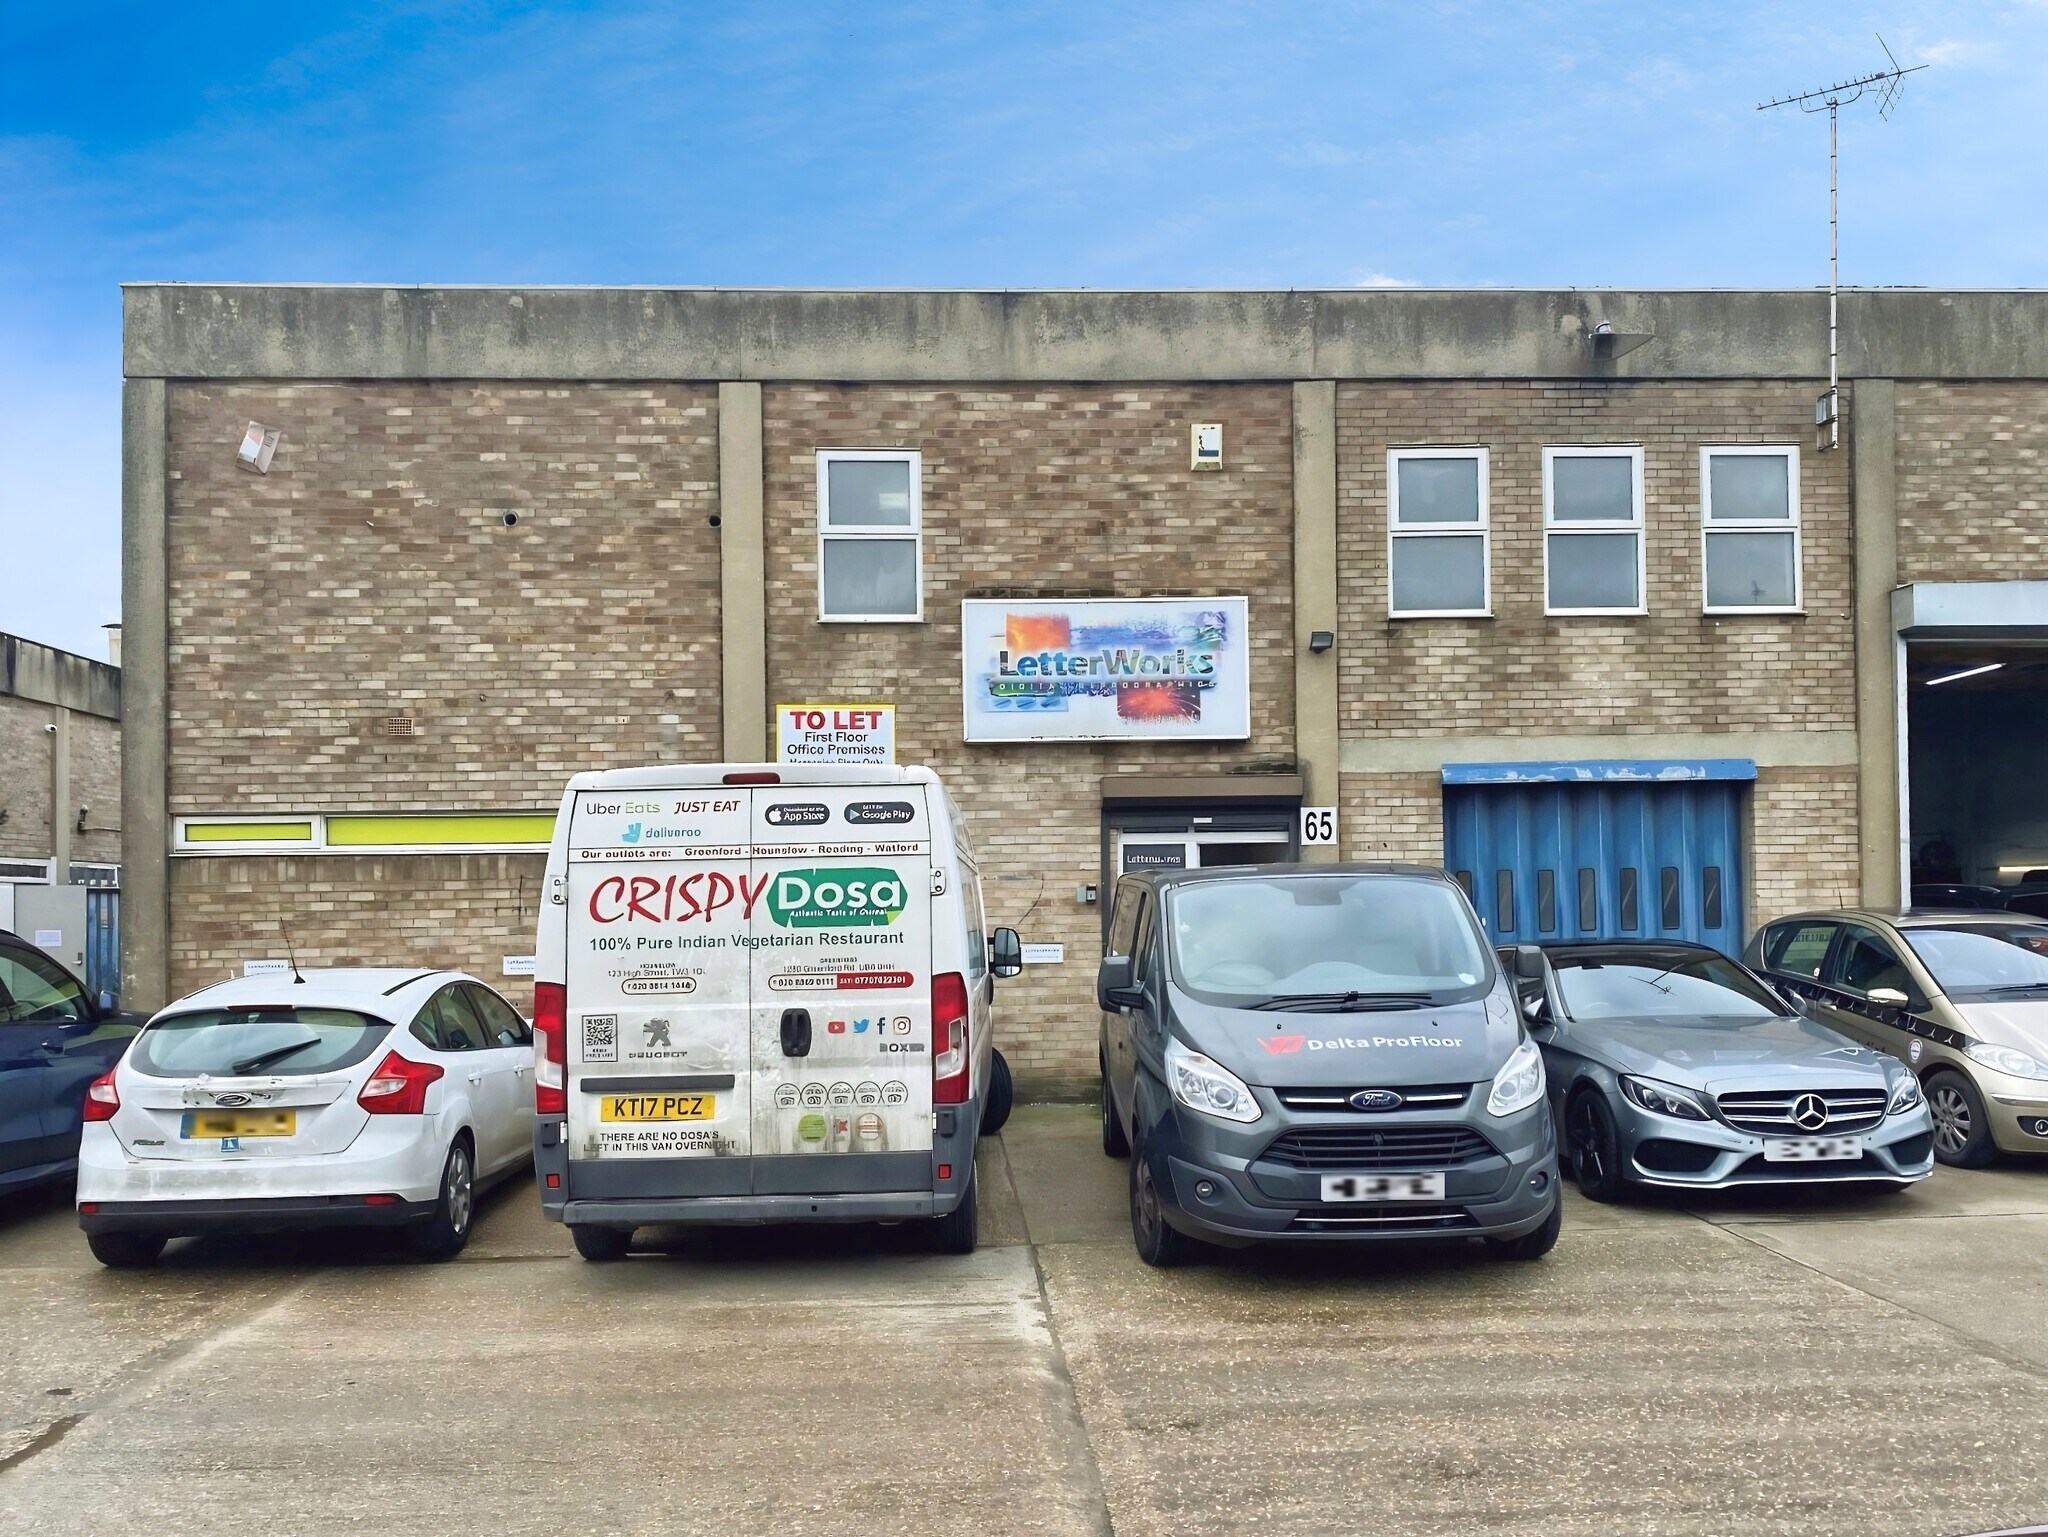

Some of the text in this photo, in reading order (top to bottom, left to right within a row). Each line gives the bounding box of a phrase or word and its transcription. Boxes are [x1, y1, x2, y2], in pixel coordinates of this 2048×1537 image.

[1000, 649, 1214, 676] LetterWorks
[789, 711, 883, 730] TO LET
[804, 731, 868, 743] First Floor
[787, 744, 885, 755] Office Premises
[586, 802, 661, 815] Uber Eats
[674, 800, 741, 814] JUST EAT
[784, 811, 826, 822] App Store
[862, 809, 911, 820] Google Play
[645, 827, 702, 839] deliveroo
[1305, 811, 1333, 841] 65
[581, 850, 602, 859] Our
[605, 849, 646, 858] outlets
[649, 849, 672, 858] are:
[684, 847, 741, 857] Greenford
[752, 845, 808, 855] Hounslow
[818, 845, 864, 855] Reading
[874, 843, 919, 853] Watford
[589, 872, 769, 924] CRISPY
[778, 876, 901, 910] Dosa
[590, 932, 904, 951] 100% Pure Indian Vegetarian Restaurant
[1307, 1037, 1370, 1051] Delta
[1362, 1092, 1391, 1106] Ford
[614, 1096, 705, 1117] KT17 PCZ
[600, 1130, 719, 1142] THERE ARE NO DOSA'S
[583, 1140, 736, 1152] LEFT IN THIS VAN OVERNIGHT
